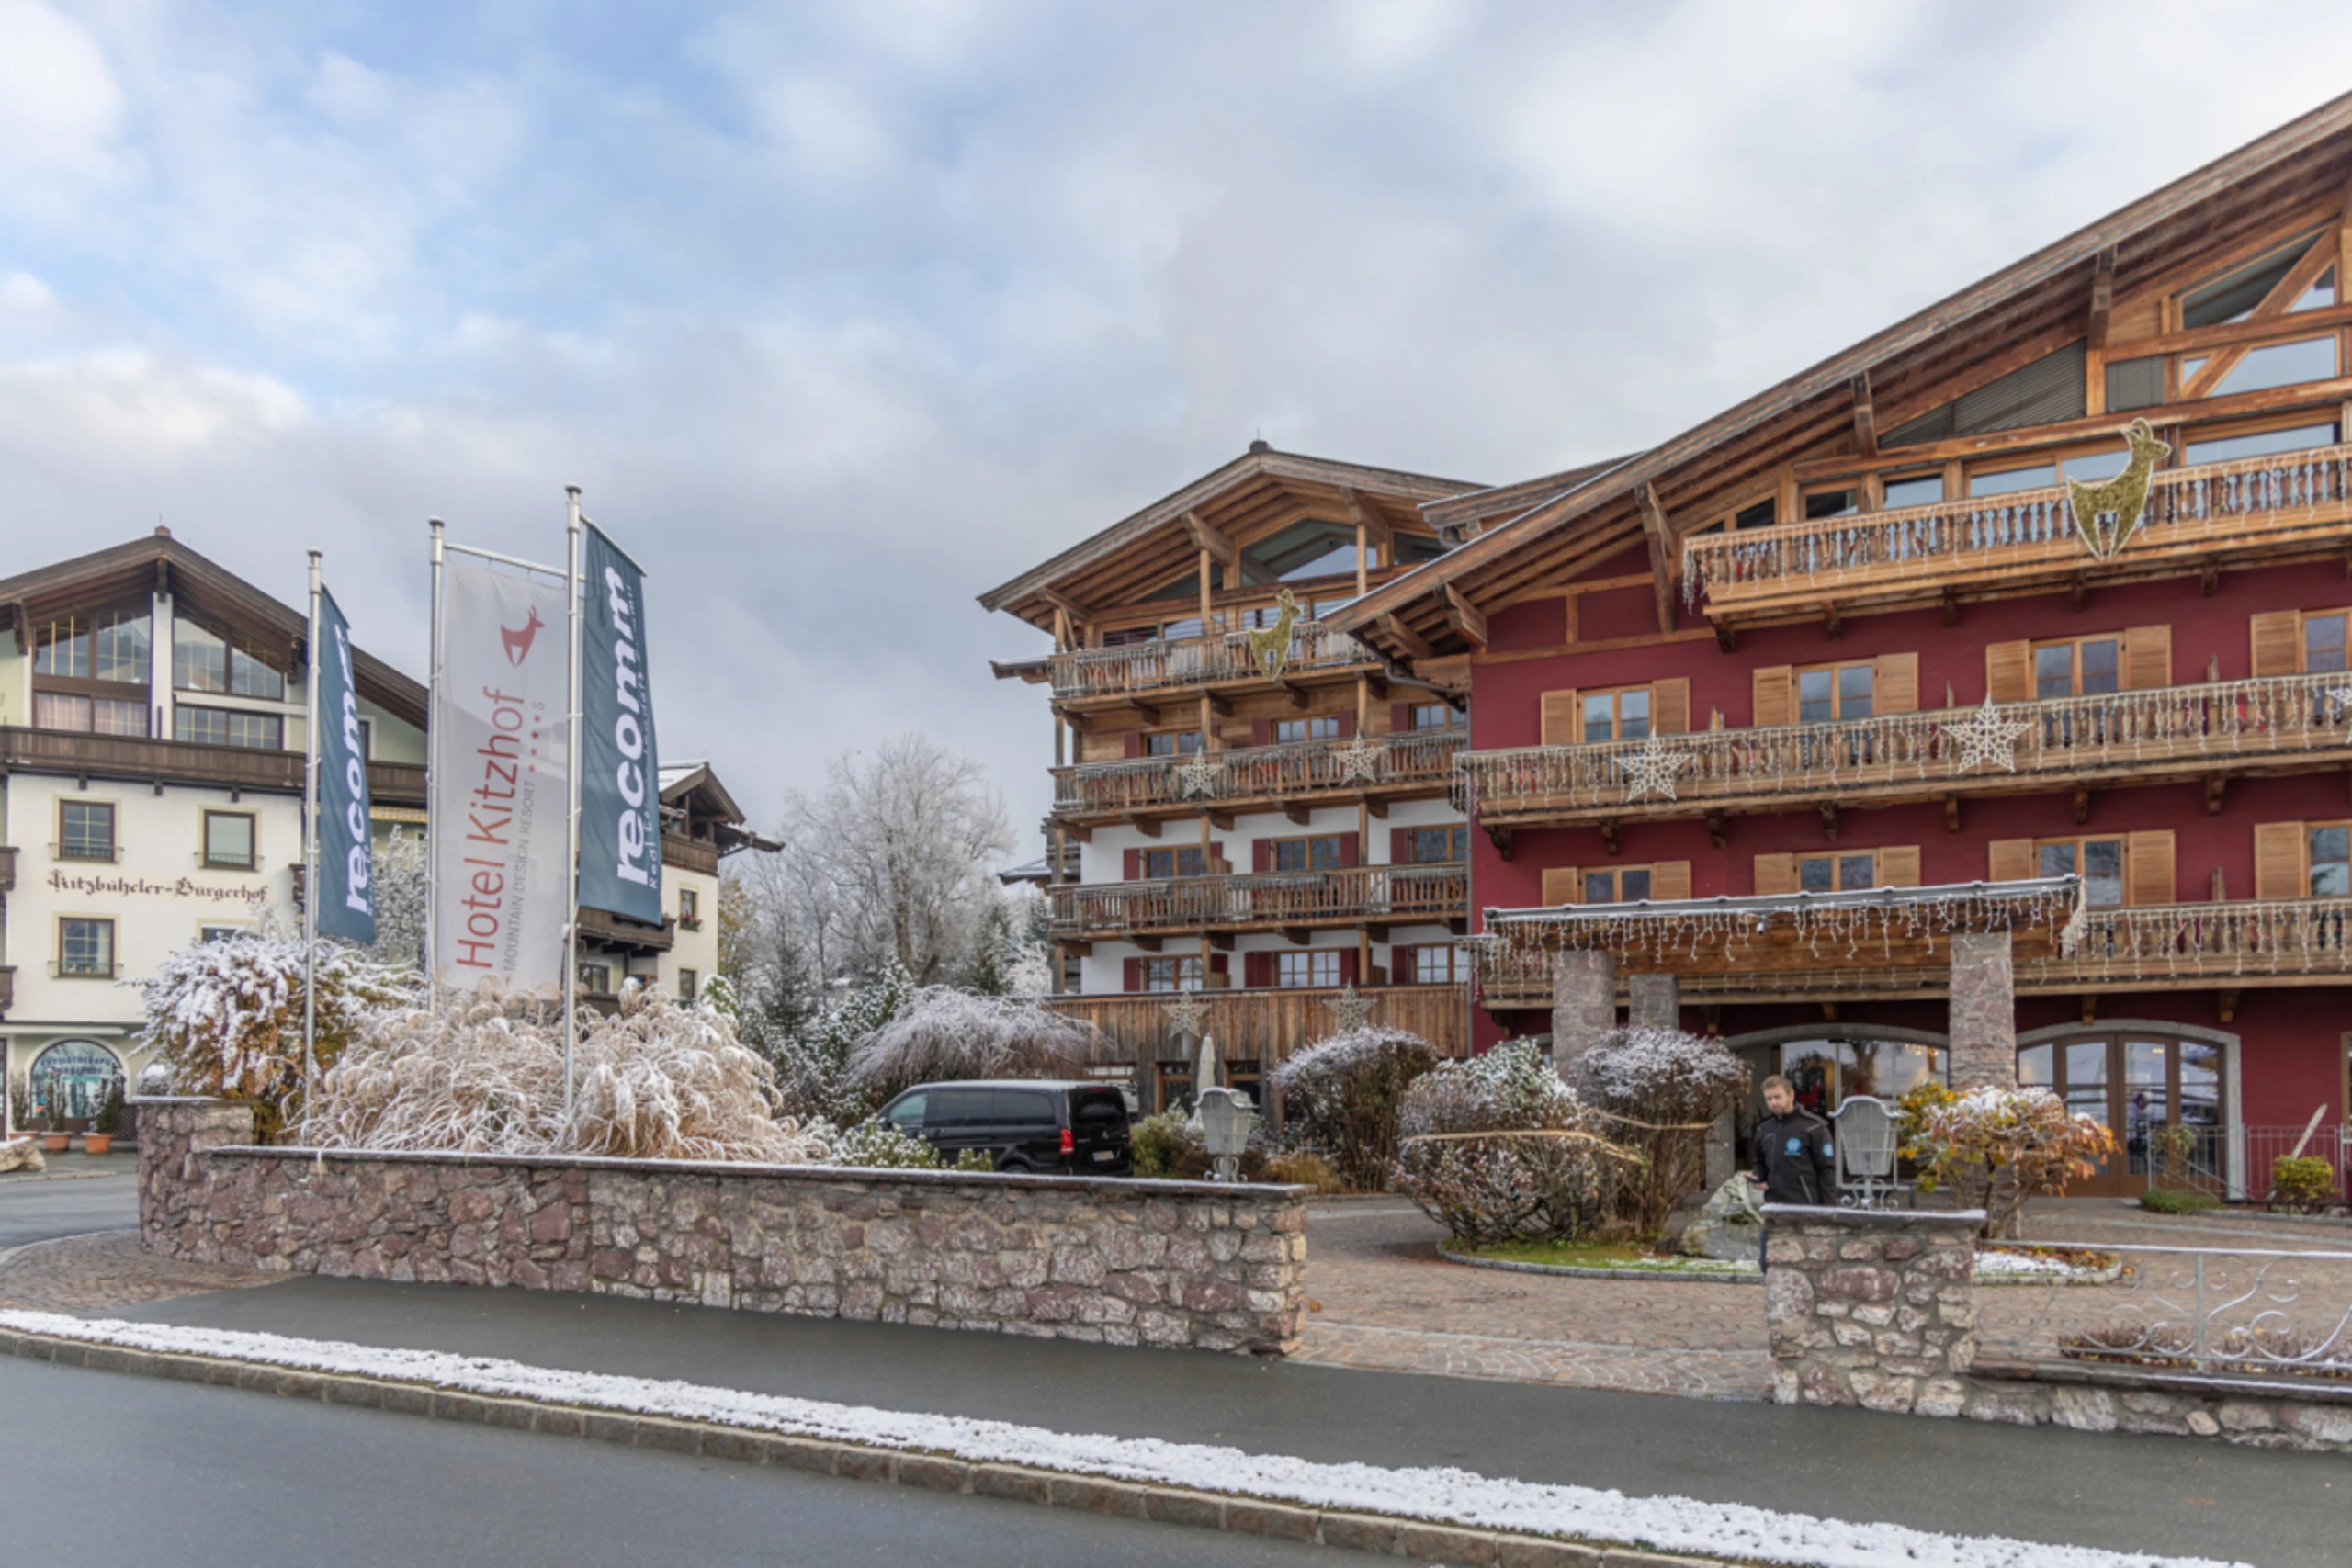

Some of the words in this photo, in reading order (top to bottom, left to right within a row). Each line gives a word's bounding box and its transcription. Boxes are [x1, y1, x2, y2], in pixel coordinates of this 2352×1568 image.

[467, 686, 525, 845] Kitzhof
[605, 566, 649, 886] recomm
[520, 780, 537, 835] RESORT
[456, 856, 506, 969] Hotel
[513, 839, 530, 892] DESIGN
[503, 896, 525, 972] MOUNTAIN
